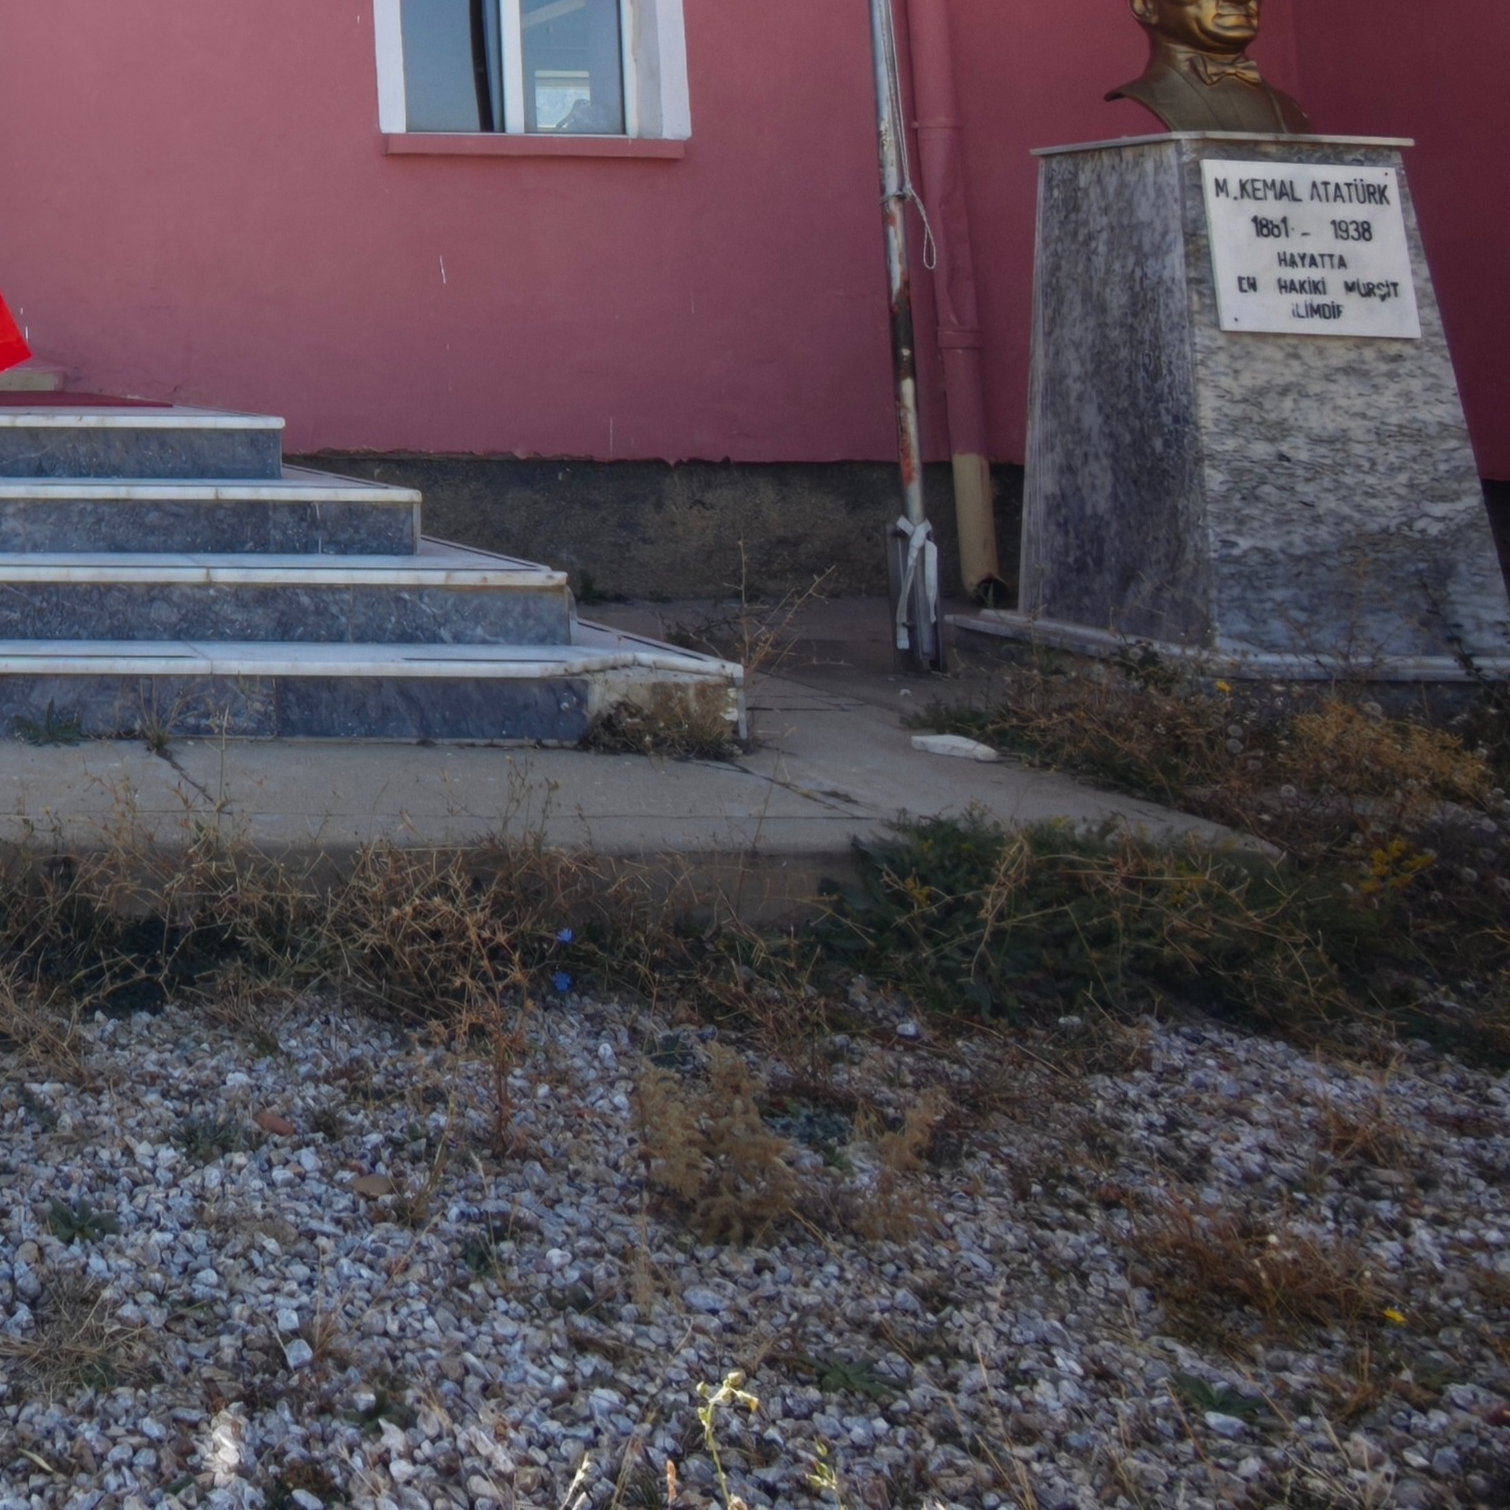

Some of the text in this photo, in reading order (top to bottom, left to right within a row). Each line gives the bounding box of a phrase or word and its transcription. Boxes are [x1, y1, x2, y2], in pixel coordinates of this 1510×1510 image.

[1310, 178, 1391, 206] ATATÜRK
[1250, 215, 1290, 239] 1881
[1330, 219, 1373, 242] 1938
[1276, 251, 1348, 270] HAYATTA
[1277, 276, 1327, 296] HAKİKİ
[1343, 278, 1400, 303] MÜRŞİT
